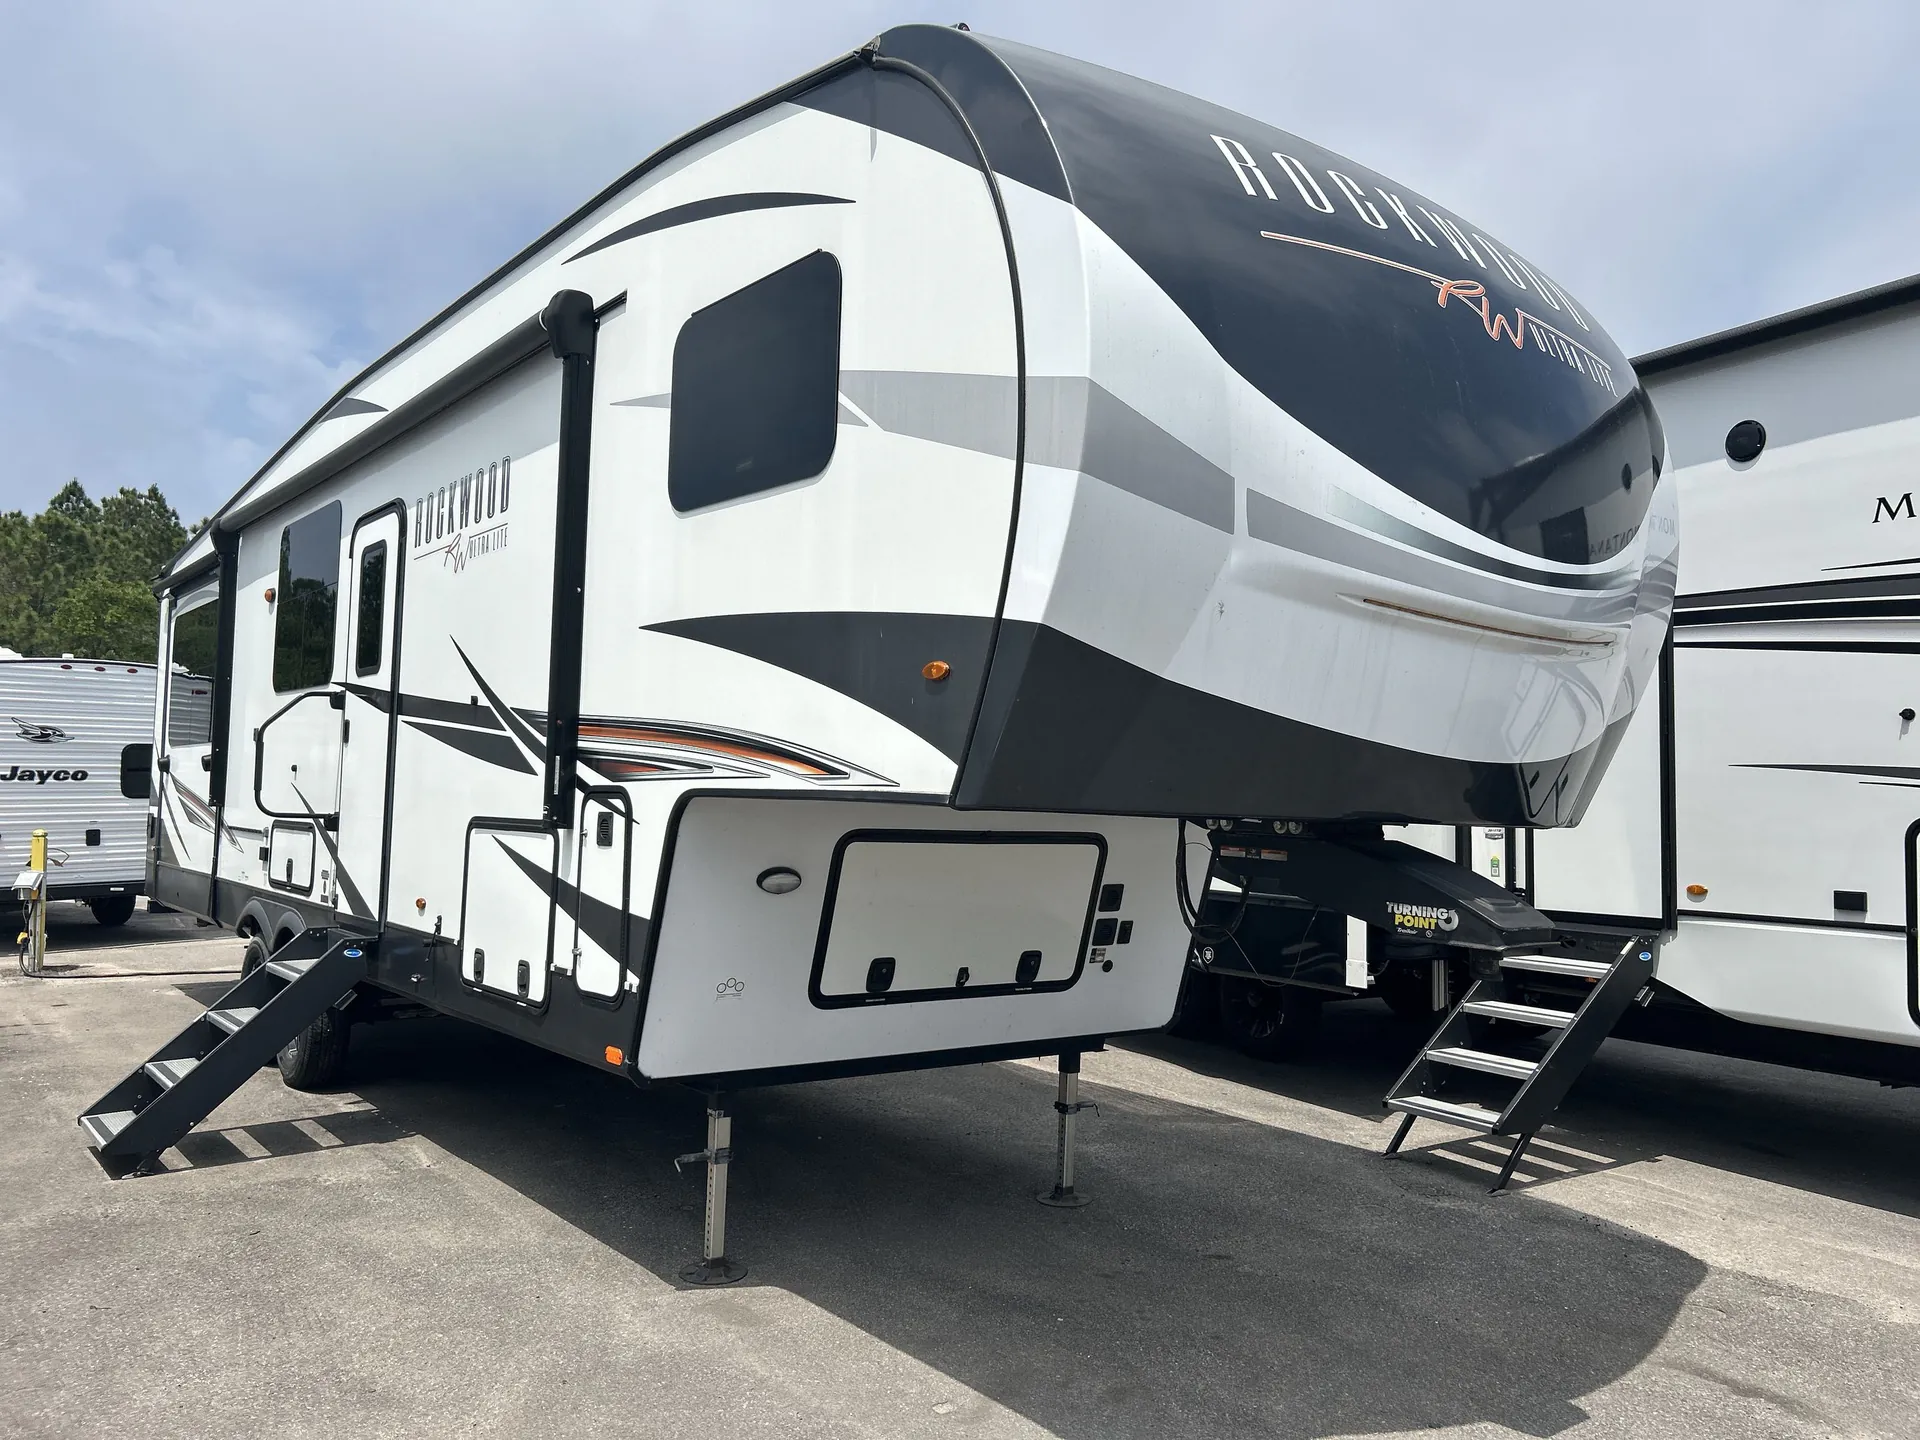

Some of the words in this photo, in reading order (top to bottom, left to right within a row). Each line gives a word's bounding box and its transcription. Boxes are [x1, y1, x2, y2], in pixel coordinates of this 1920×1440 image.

[1209, 134, 1591, 332] ROCKWOOD
[1529, 323, 1586, 374] ULTRA
[1583, 354, 1619, 398] LITE
[414, 455, 511, 549] ROCKWOOD
[0, 765, 88, 785] Jayco
[1386, 901, 1449, 920] TURNING
[1394, 914, 1437, 929] POINT
